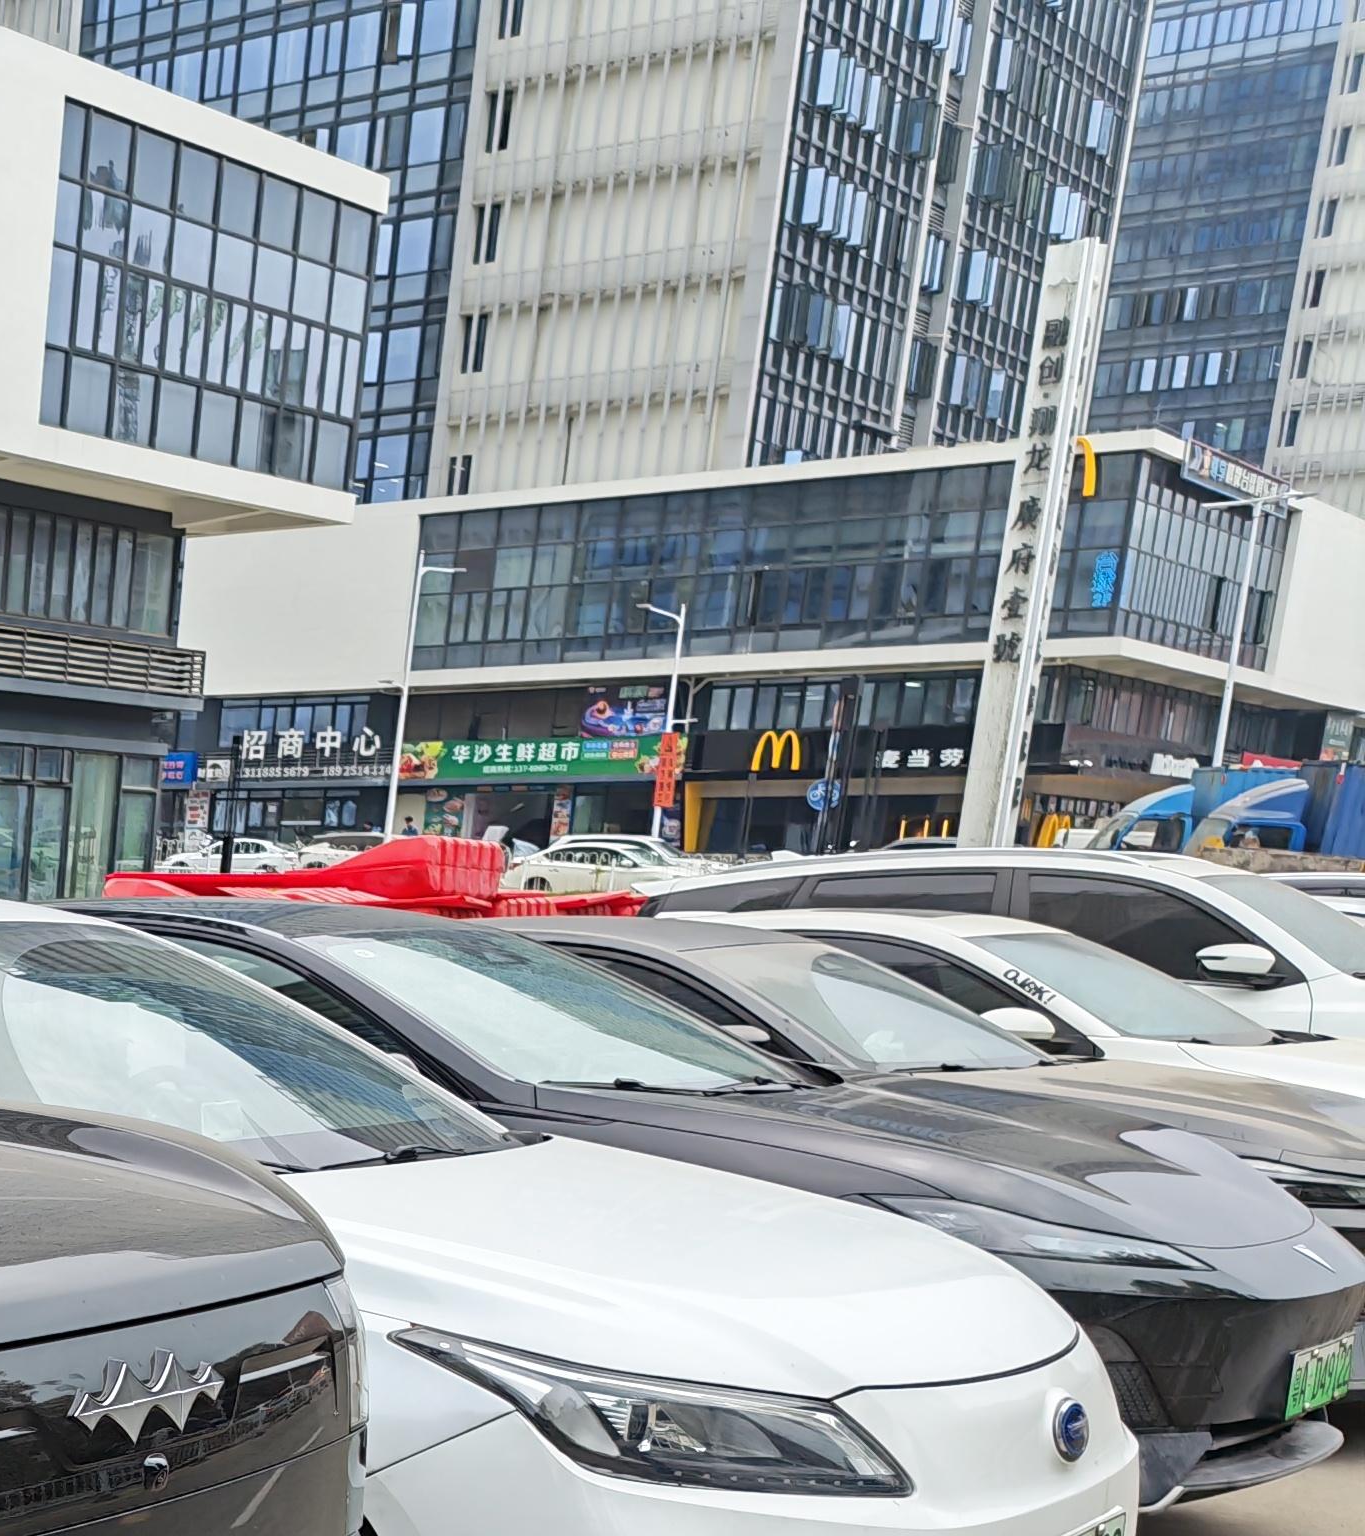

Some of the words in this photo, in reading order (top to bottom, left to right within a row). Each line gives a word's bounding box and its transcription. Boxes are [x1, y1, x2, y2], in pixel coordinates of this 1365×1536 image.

[241, 725, 381, 760] 招商中心
[451, 741, 579, 763] 华沙生鲜超市
